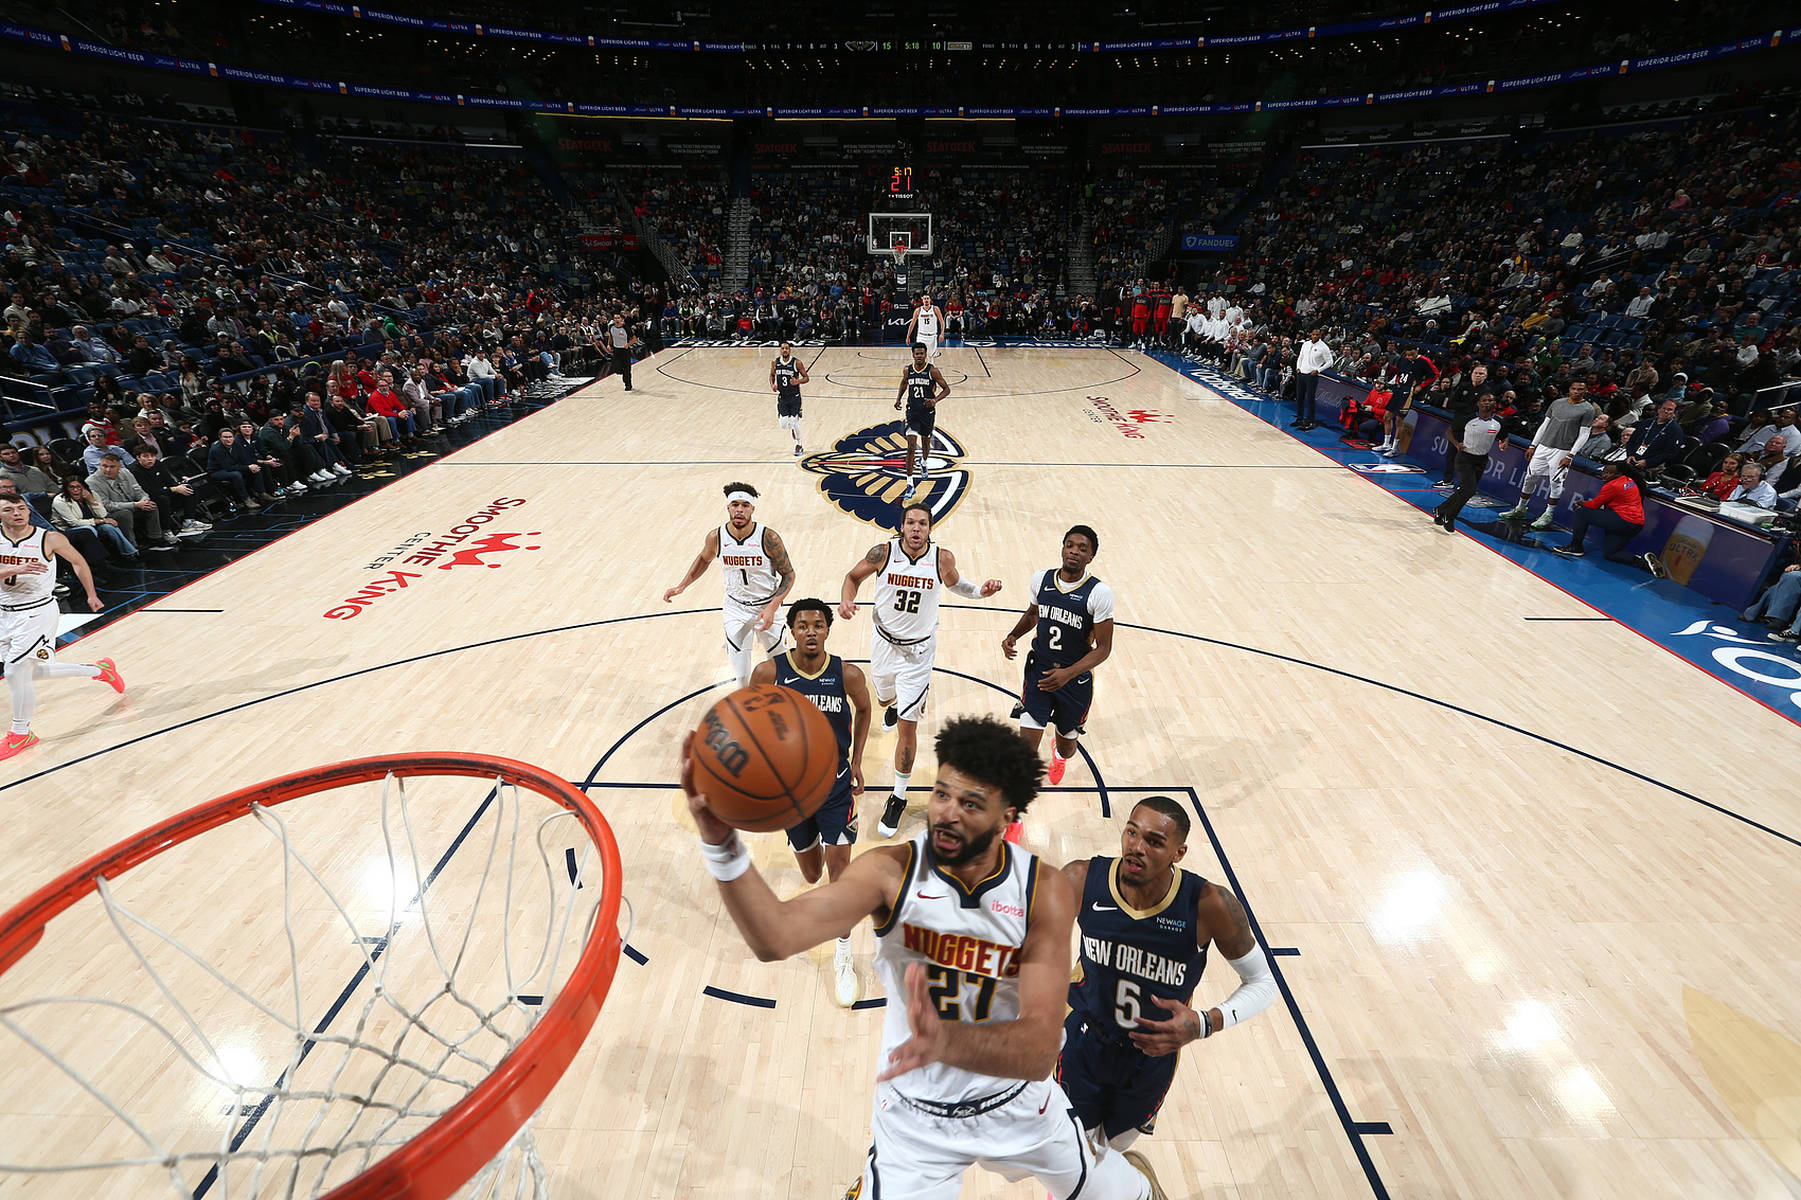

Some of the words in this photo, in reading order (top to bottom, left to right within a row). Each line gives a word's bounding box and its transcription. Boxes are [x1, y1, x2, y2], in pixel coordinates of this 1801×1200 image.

[325, 3, 344, 12] ULTRA
[1438, 7, 1466, 18] SUPERIOR
[1467, 5, 1482, 14] LIGHT
[1484, 2, 1499, 11] BEER
[368, 11, 393, 21] SUPERIOR
[409, 17, 423, 25] BEER
[30, 31, 52, 42] ULTRA
[1741, 40, 1761, 48] ULTRA
[78, 42, 109, 56] SUPERIOR
[110, 48, 126, 58] LIGHT
[127, 51, 144, 62] BEER
[883, 42, 892, 50] 15
[905, 42, 920, 50] 5:18
[932, 42, 941, 50] 10
[180, 61, 200, 70] ULTRA
[1637, 55, 1670, 67] SUPERIOR
[1671, 53, 1689, 62] LIGHT
[1690, 50, 1708, 60] BEER
[225, 68, 252, 78] SUPERIOR
[253, 72, 268, 81] LIGHT
[269, 74, 284, 83] BEER
[1591, 65, 1610, 73] ULTRA
[354, 86, 380, 94] SUPERIOR
[1502, 78, 1529, 88] SUPERIOR
[894, 167, 912, 176] 5:17
[890, 176, 910, 192] 21
[1198, 239, 1234, 247] FANDUEL
[782, 376, 788, 387] 3
[1399, 373, 1409, 384] 24
[914, 386, 924, 398] 21
[1432, 436, 1505, 480] SUOR
[402, 496, 527, 566] SMOOTHIE
[363, 532, 431, 570] CENTER
[722, 556, 762, 566] NUGGETS
[740, 569, 748, 586] 1
[888, 573, 934, 590] NUGGETS
[894, 590, 922, 614] 32
[1050, 606, 1082, 630] ORLEANS
[1049, 626, 1062, 650] 2
[804, 694, 842, 713] RLEANS
[992, 899, 1024, 917] ibotta
[902, 920, 1023, 979] NUGGETS
[1083, 934, 1112, 966] NEW
[1115, 943, 1187, 986] ORLEANS
[927, 964, 997, 1022] 27
[1114, 980, 1142, 1029] 5
